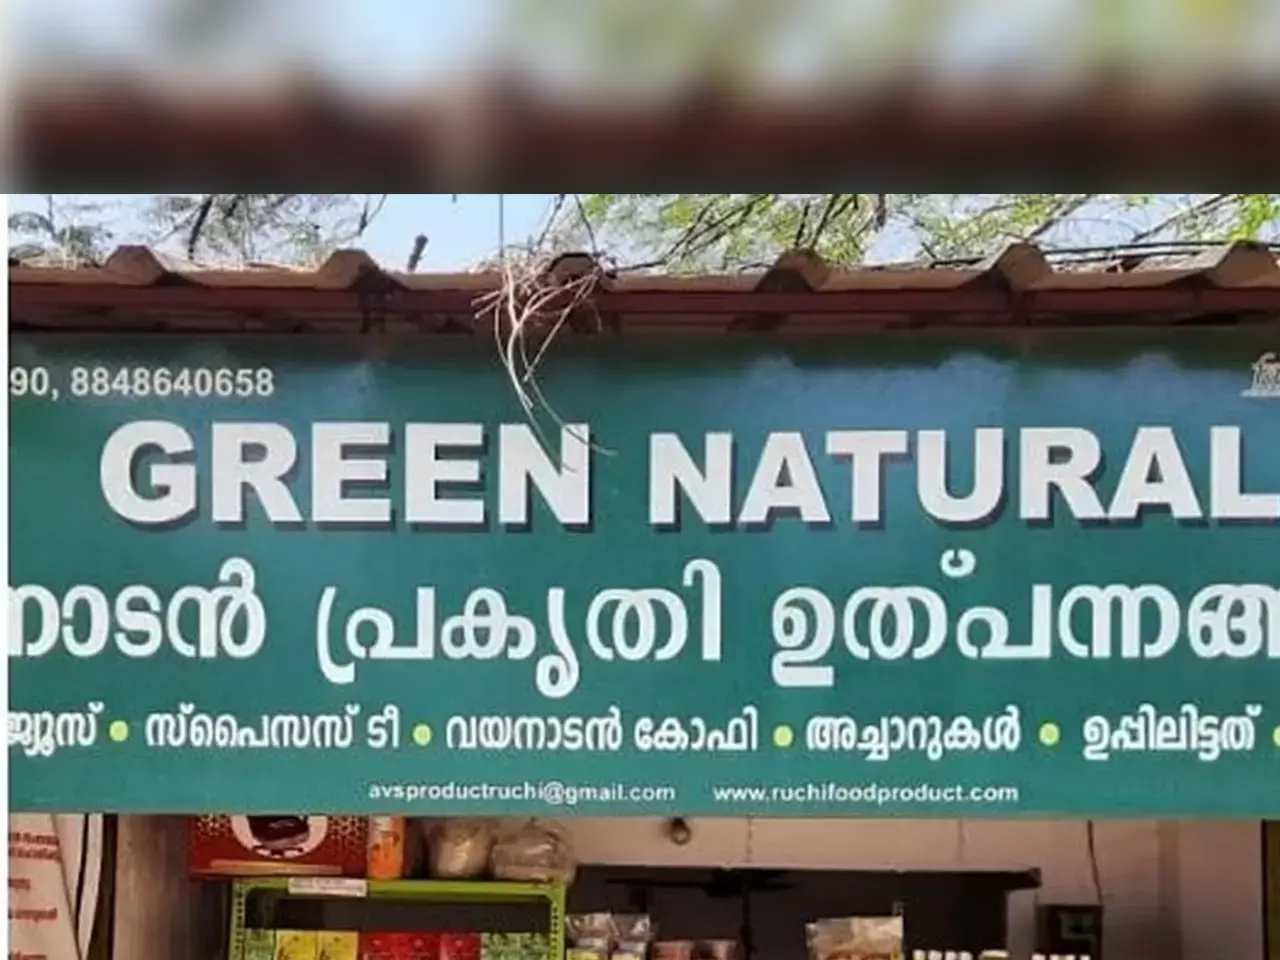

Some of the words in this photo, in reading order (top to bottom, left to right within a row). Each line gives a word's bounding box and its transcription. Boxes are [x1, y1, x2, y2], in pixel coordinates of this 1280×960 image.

[9, 366, 59, 401] 90,
[70, 366, 275, 397] 8848640658
[100, 421, 590, 523] GREEN
[650, 426, 1280, 524] NATURAL
[317, 559, 721, 698] പ്രകൃതി
[145, 703, 360, 749] സ്പൈസസ്
[366, 704, 400, 749] ടീ
[446, 706, 623, 751] വയനാടൻ
[634, 706, 758, 751] കോഫി
[806, 705, 1021, 761] അച്ചാറുകൾ
[1082, 703, 1263, 761] ഉപ്പിലിട്ടത്
[368, 781, 676, 805] avsproductruchi@gmail.com
[713, 782, 1020, 806] www.ruchifoodproduct.com
